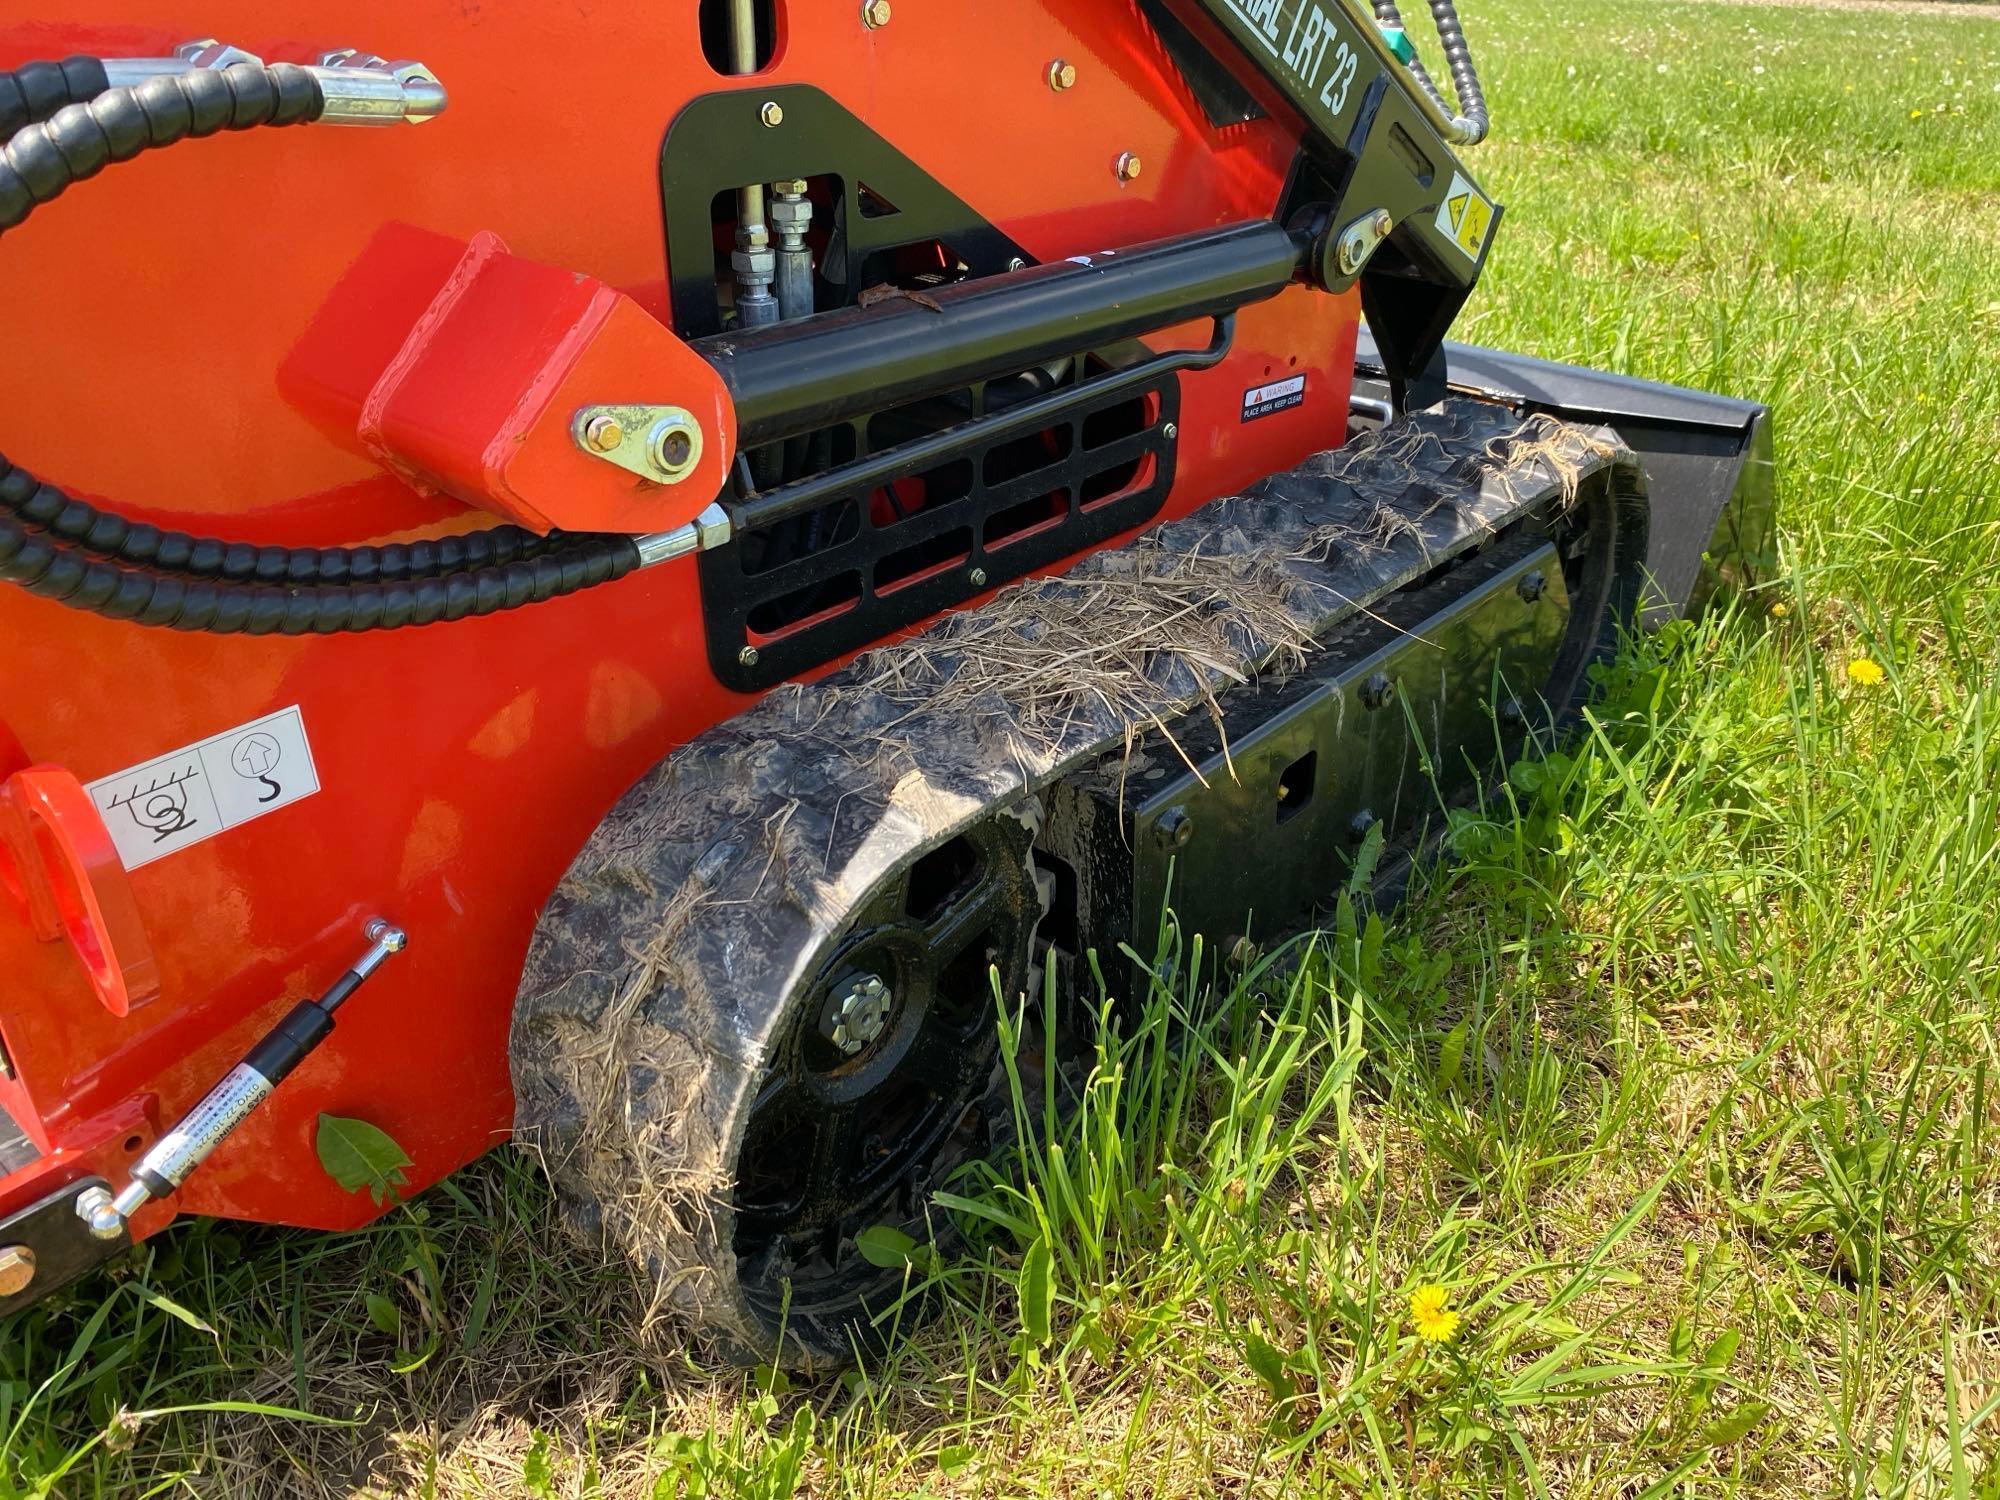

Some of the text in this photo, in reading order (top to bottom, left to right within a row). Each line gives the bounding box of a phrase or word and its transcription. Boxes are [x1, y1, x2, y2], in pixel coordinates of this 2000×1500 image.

[1282, 0, 1337, 88] LRT
[1320, 42, 1358, 116] 23
[1244, 407, 1260, 418] PLACE
[1274, 398, 1287, 409] KEEP
[1287, 394, 1303, 405] CLEAR
[1266, 382, 1295, 398] WARING
[212, 1089, 266, 1146] GAS SPRING
